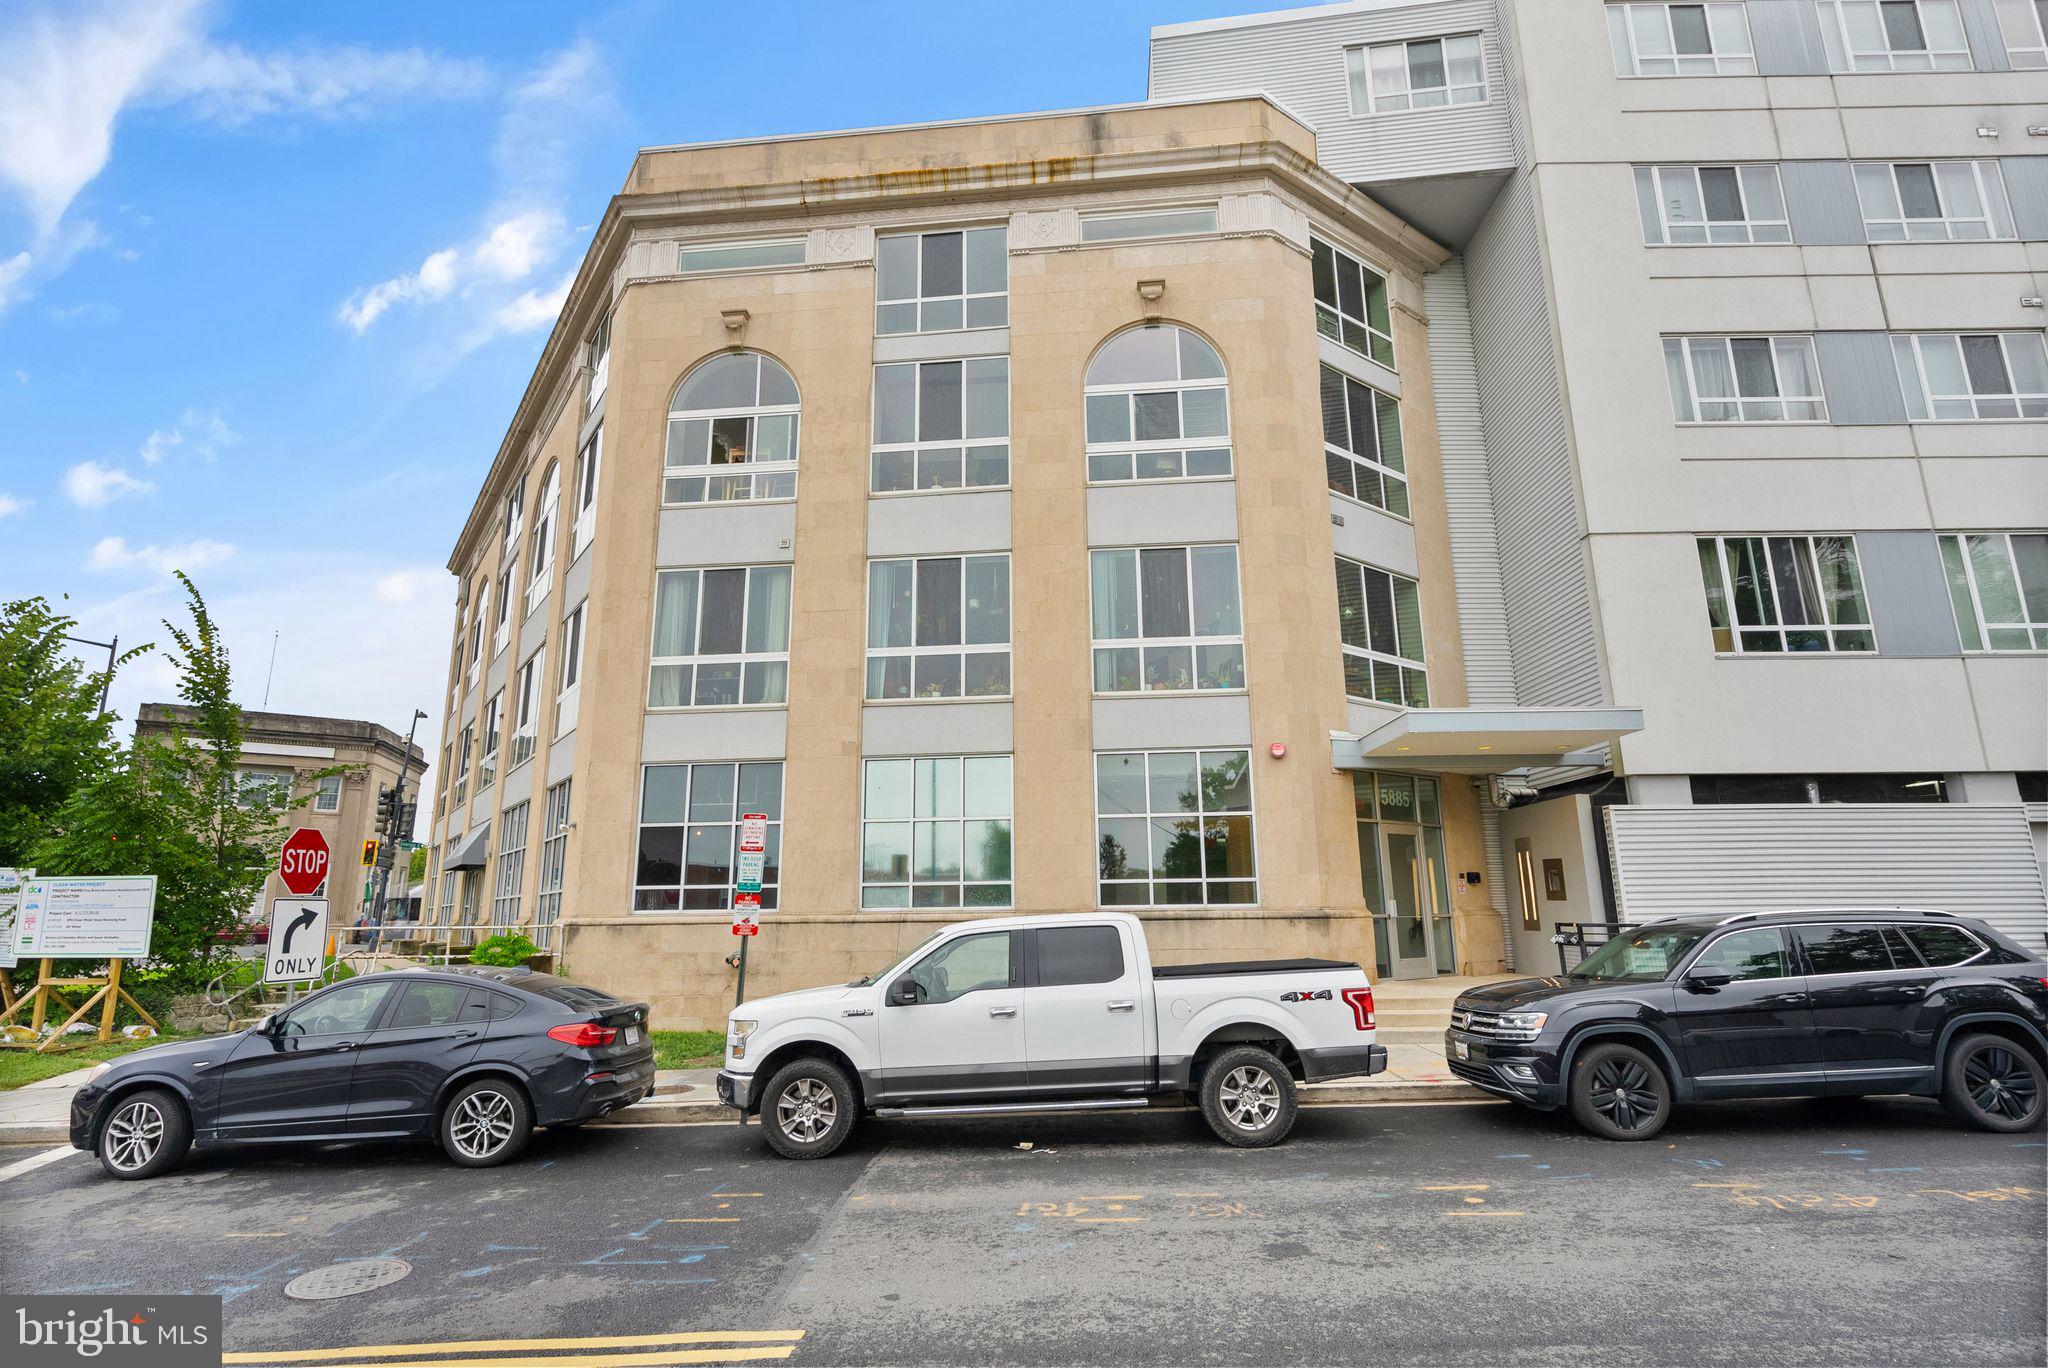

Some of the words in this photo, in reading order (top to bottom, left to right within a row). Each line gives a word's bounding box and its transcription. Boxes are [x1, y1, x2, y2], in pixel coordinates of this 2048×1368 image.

[1381, 788, 1410, 808] 5885
[283, 848, 327, 874] STOP
[274, 957, 317, 976] ONLY
